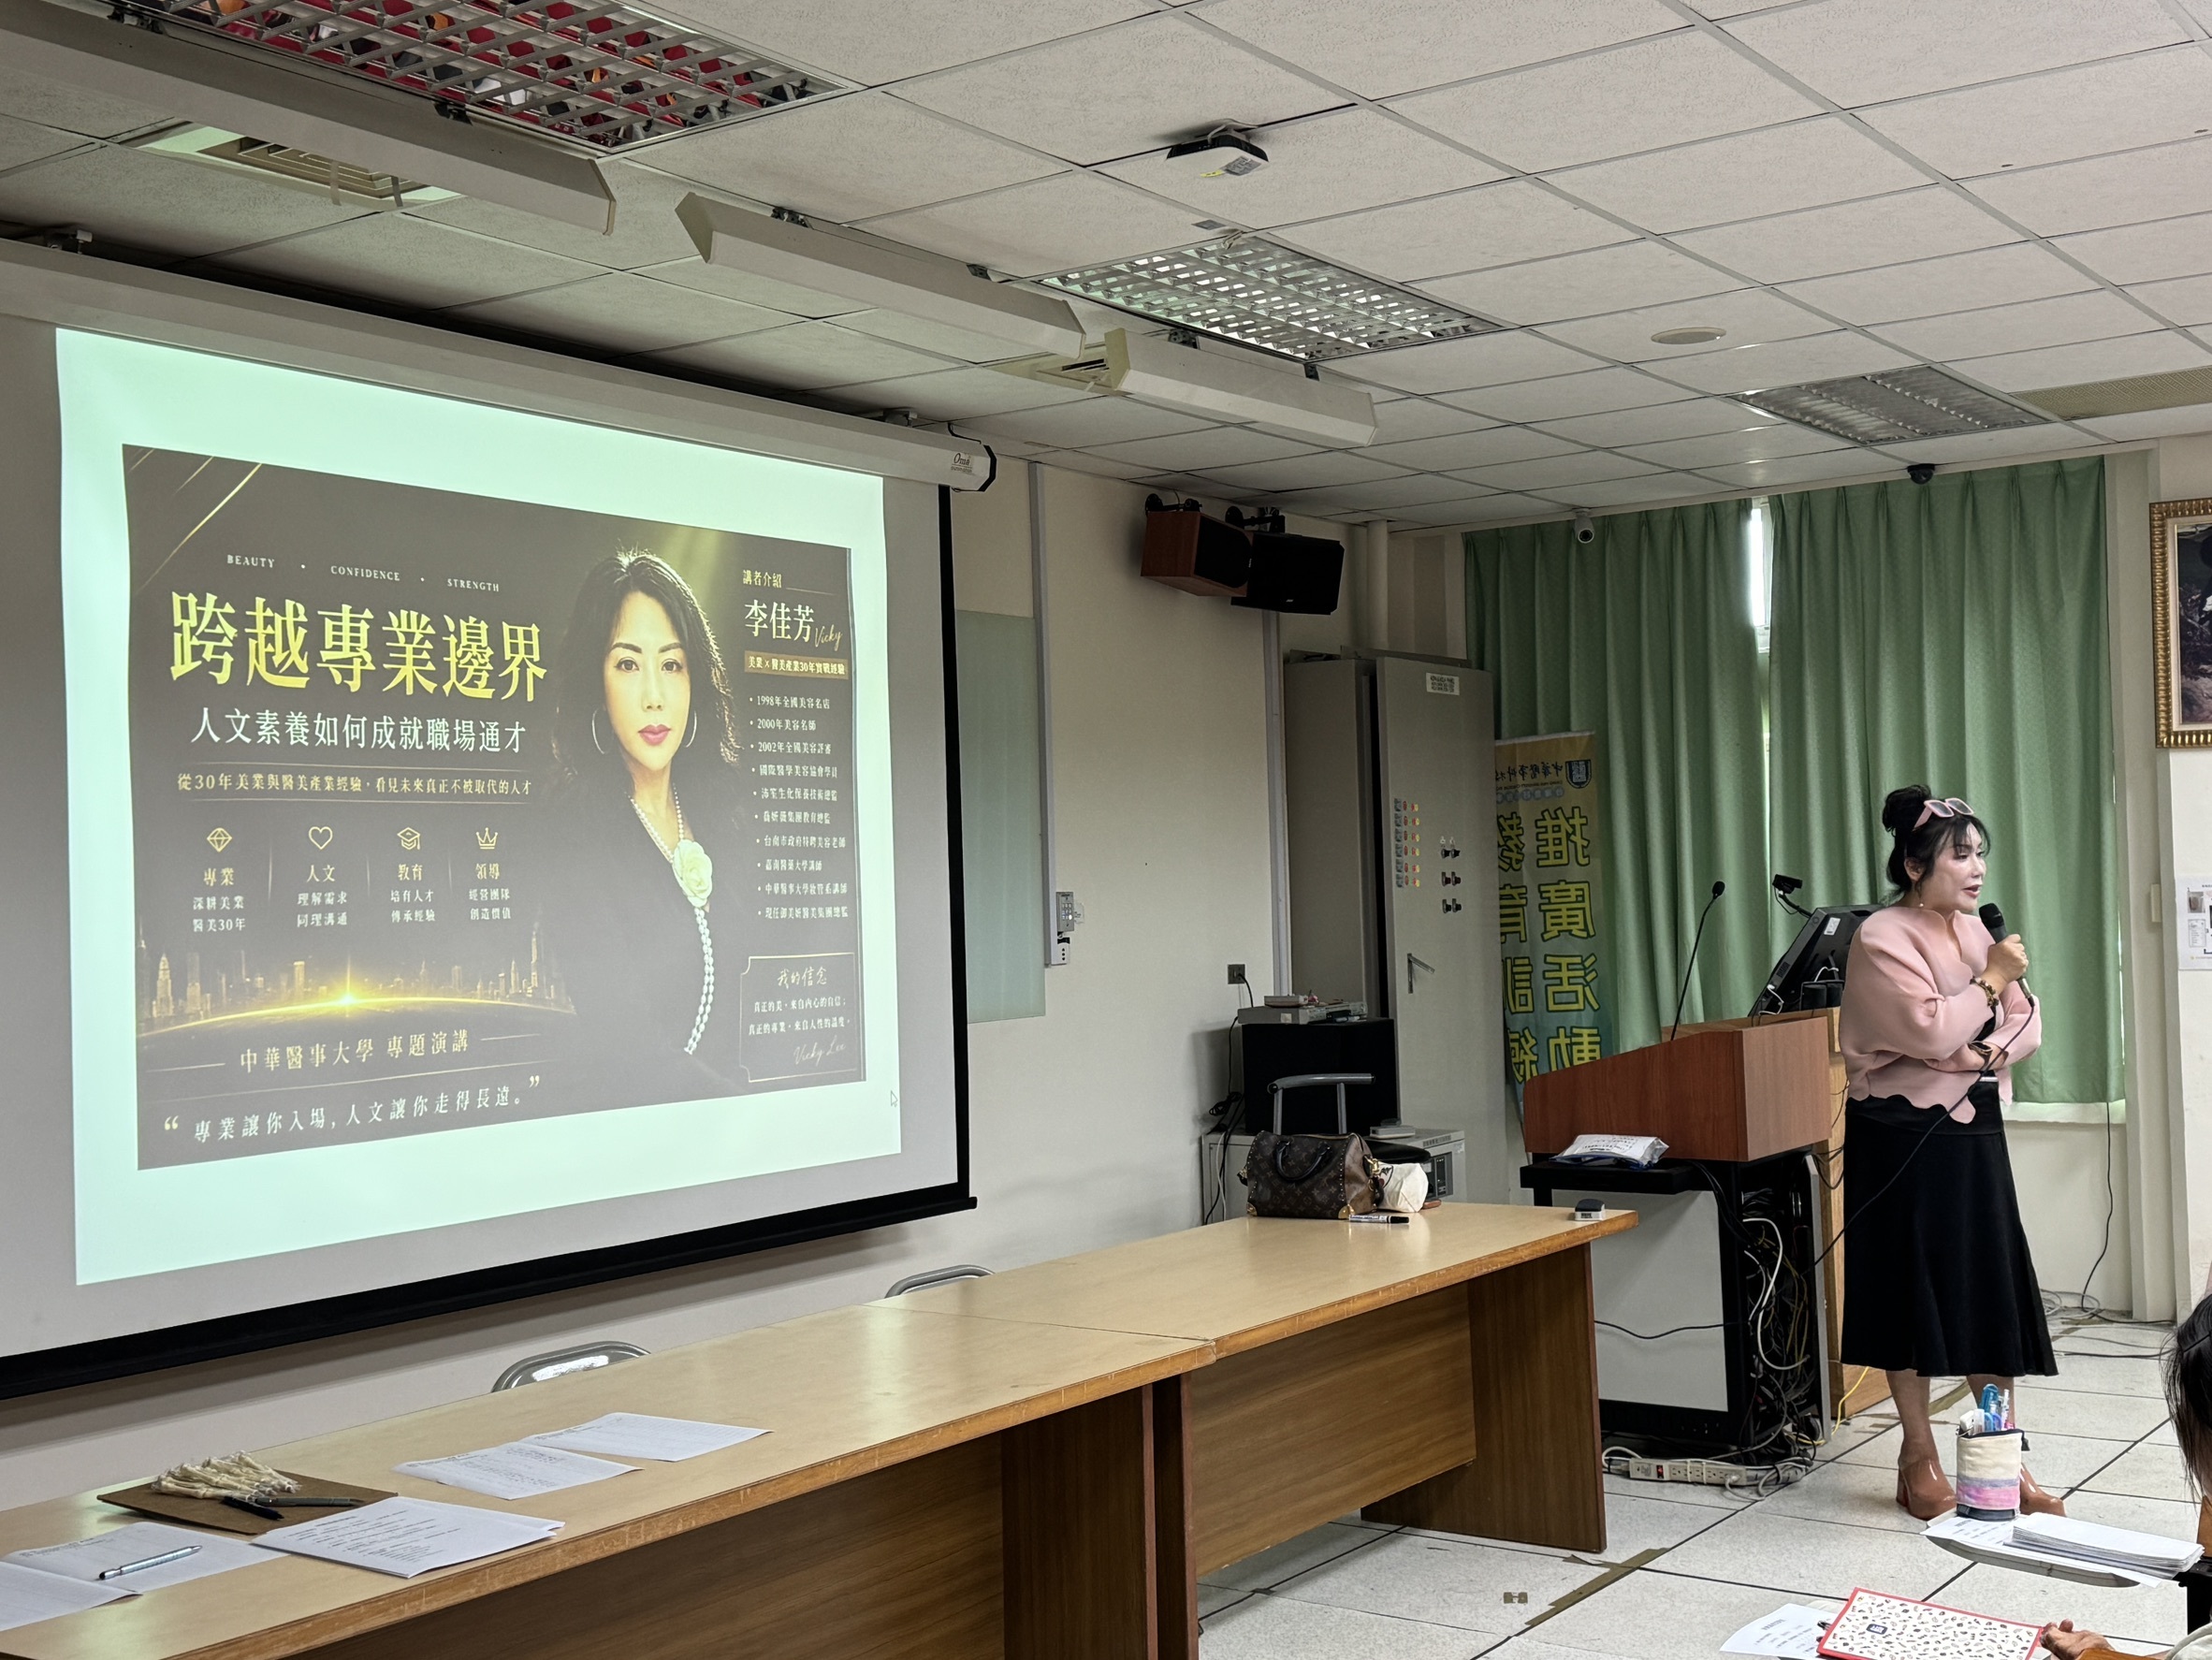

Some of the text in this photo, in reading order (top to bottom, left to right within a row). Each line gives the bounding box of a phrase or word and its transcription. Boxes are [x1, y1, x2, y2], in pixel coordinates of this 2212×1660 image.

[226, 554, 499, 591] BEAUTY CONFIDENCE STRENGTH
[742, 569, 781, 588] 講者介紹
[744, 599, 843, 651] 李佳芳 Vicky
[170, 590, 547, 703] 跨越專業邊界
[190, 706, 527, 754] 人文素養如何成就職場通才
[203, 866, 234, 886] 專業
[305, 864, 335, 882] 人文
[398, 864, 423, 881] 教育
[474, 862, 500, 880] 領導
[390, 889, 434, 903] 培育人才
[192, 917, 245, 932] 醫美30年
[777, 965, 828, 990] 我的信念
[240, 1028, 470, 1074] 中華醫事大學 專題演講
